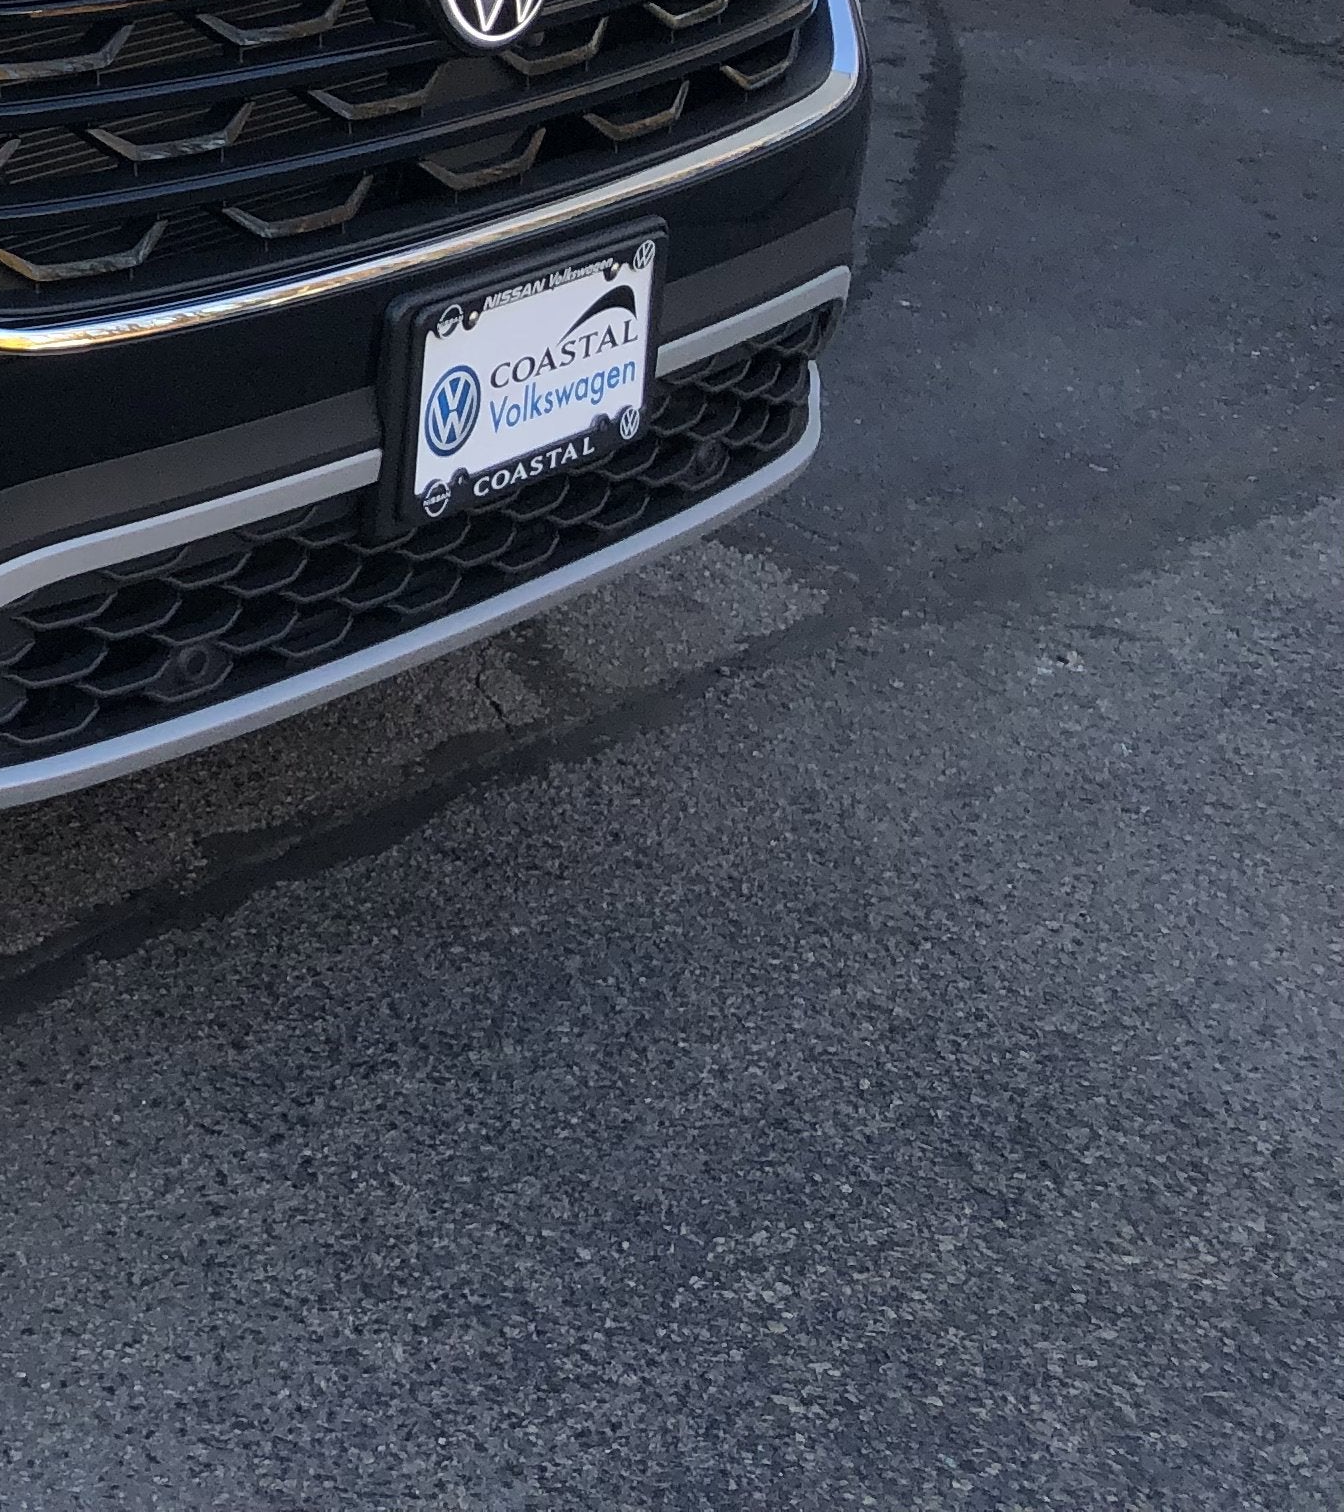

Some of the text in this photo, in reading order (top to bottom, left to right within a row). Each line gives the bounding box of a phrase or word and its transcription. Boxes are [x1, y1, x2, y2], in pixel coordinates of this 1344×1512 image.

[483, 278, 546, 311] NISSAN
[490, 319, 639, 389] COASTAL
[489, 361, 636, 434] Volkswagen
[473, 436, 596, 497] COASTAL
